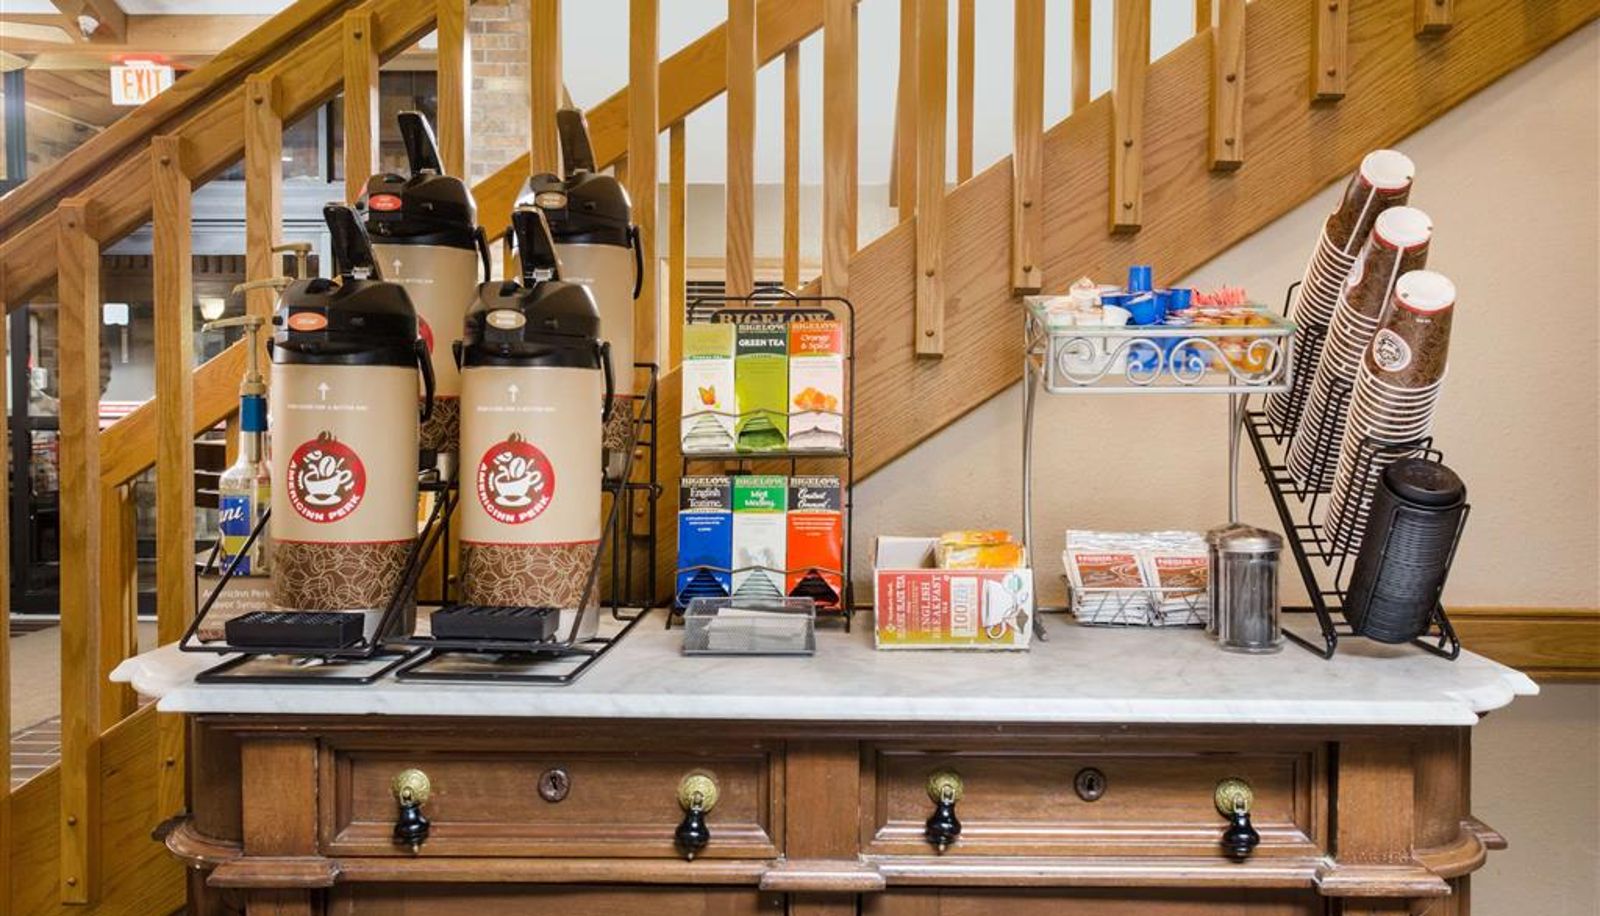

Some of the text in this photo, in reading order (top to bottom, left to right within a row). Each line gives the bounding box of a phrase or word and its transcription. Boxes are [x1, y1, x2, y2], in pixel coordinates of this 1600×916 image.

[122, 69, 161, 99] EXIT
[719, 313, 830, 324] BIGELOW
[739, 338, 785, 347] GREEN TEA
[288, 460, 361, 520] AMERICINN PERK
[479, 462, 550, 522] AMERICINN PERK
[682, 477, 730, 486] BIGELOW
[690, 487, 721, 499] English
[790, 477, 839, 486] BIGELOW
[921, 582, 931, 633] ENGLISH
[932, 575, 942, 639] BREAKFAST
[953, 605, 968, 632] 100
